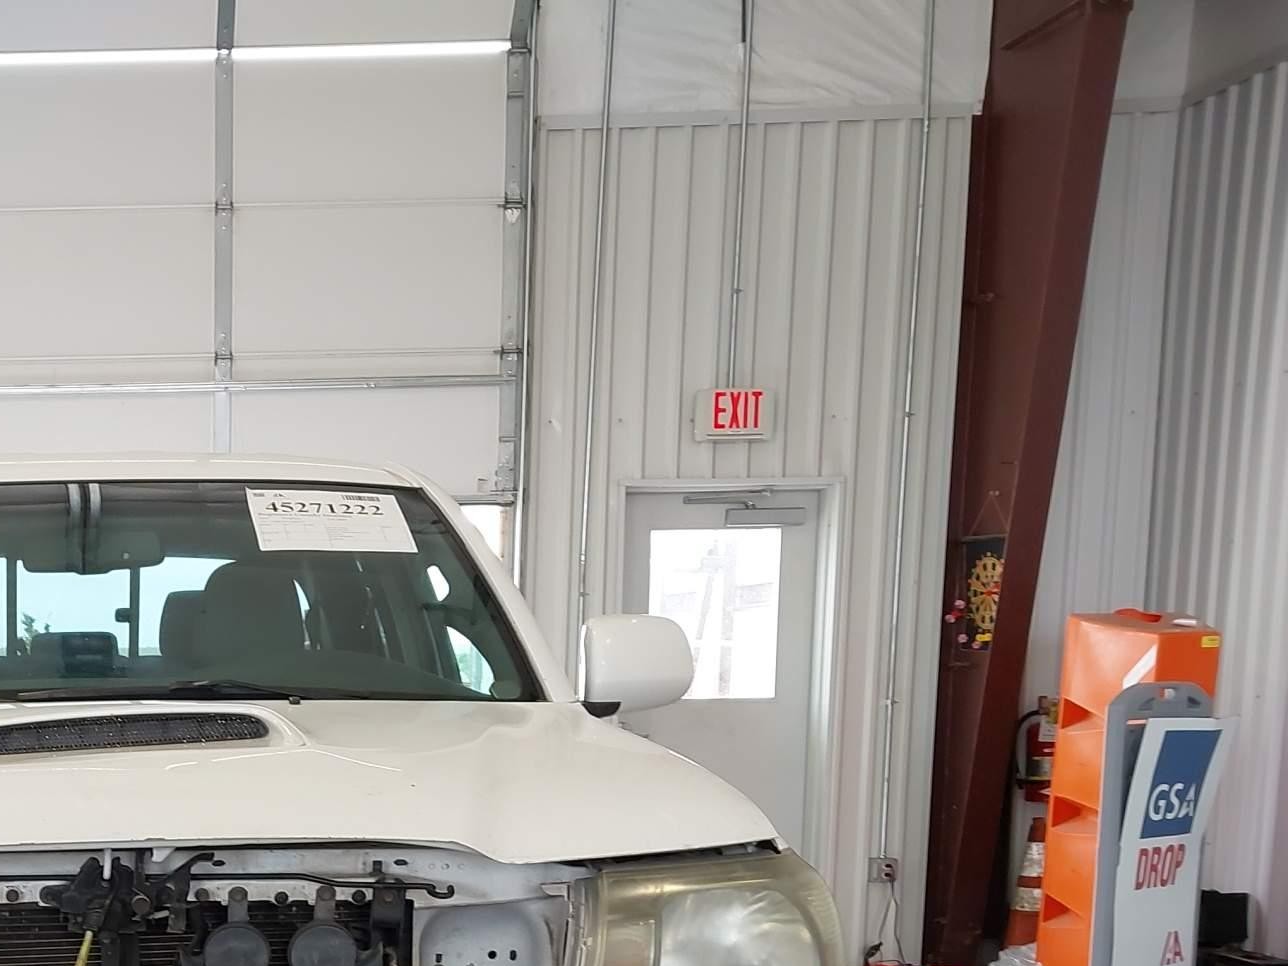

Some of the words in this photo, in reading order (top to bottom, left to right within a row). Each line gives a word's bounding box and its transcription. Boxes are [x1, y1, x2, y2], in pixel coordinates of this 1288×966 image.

[713, 391, 764, 429] EXIT
[264, 501, 385, 516] 45271222
[1148, 782, 1197, 821] GSA
[1133, 843, 1186, 891] DROP
